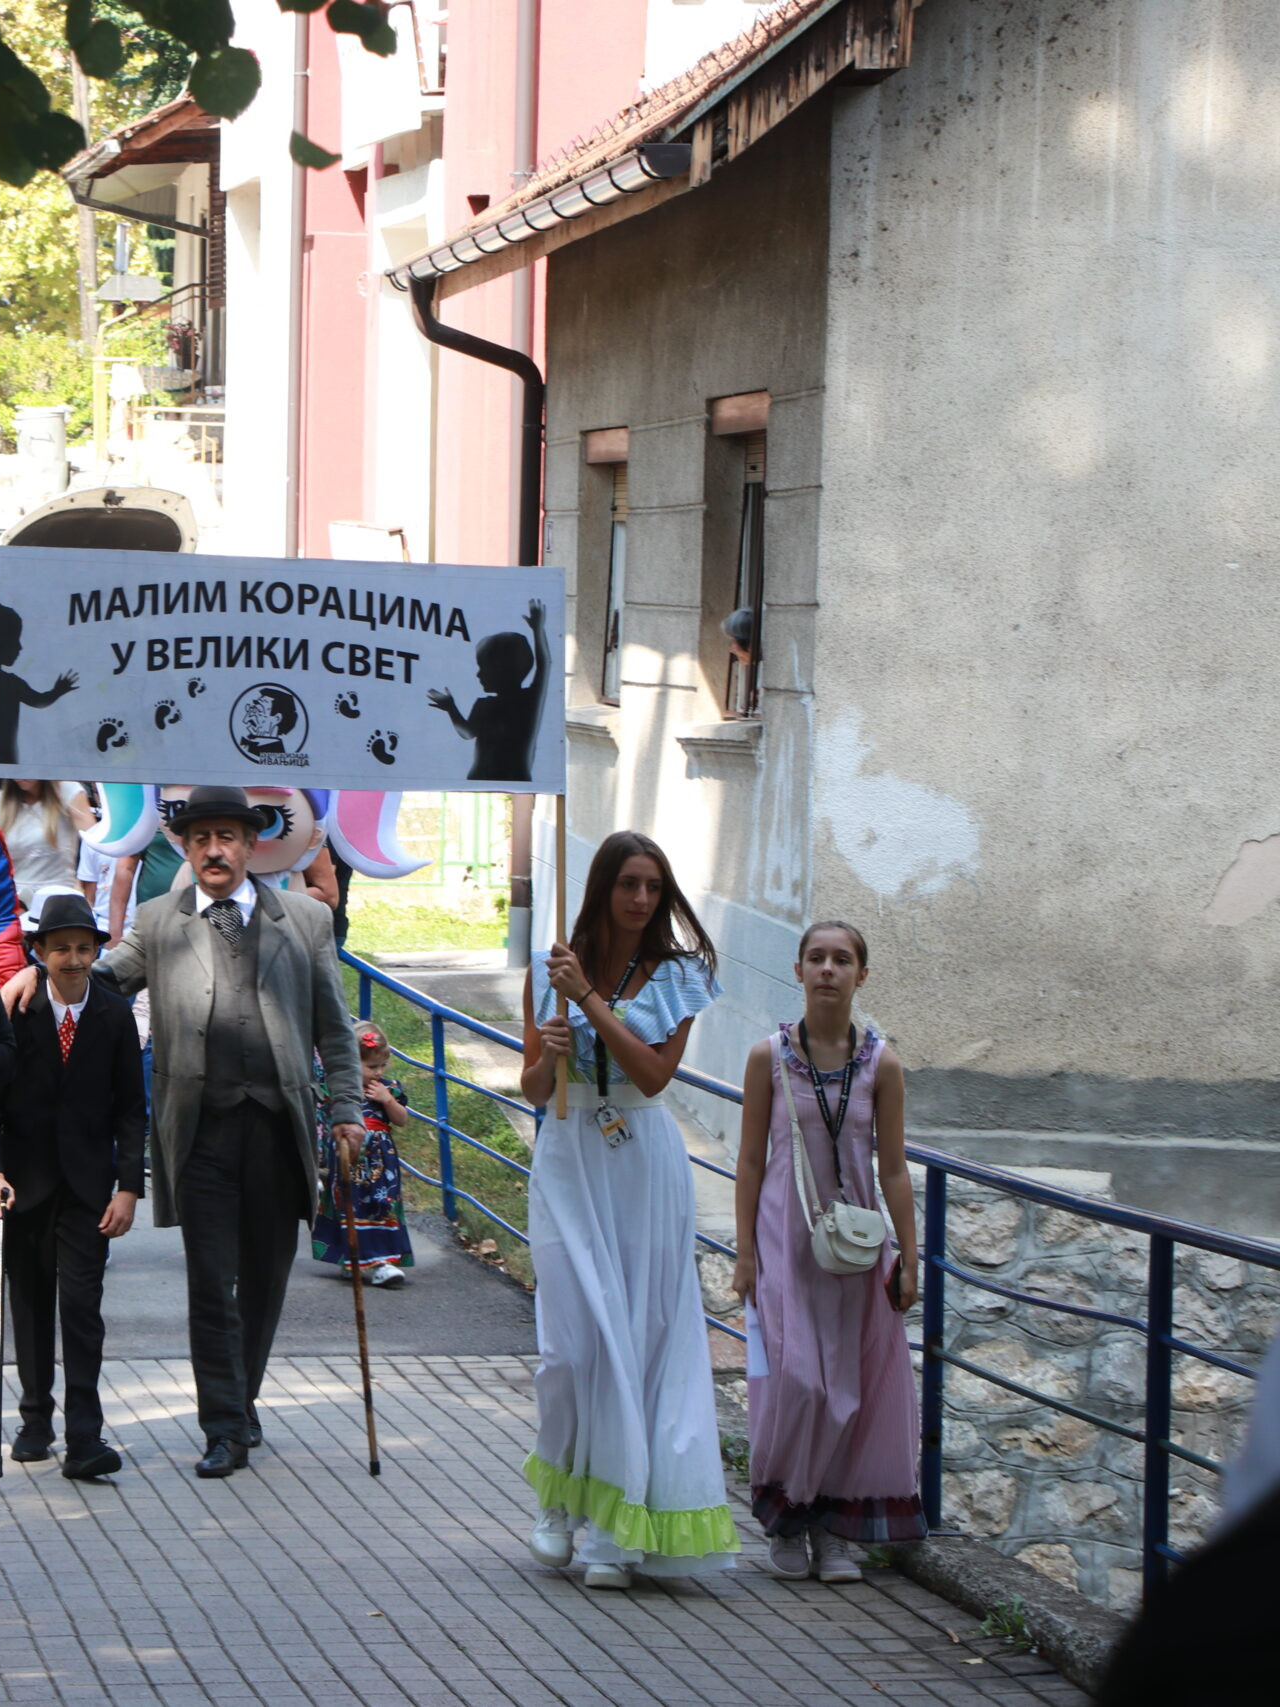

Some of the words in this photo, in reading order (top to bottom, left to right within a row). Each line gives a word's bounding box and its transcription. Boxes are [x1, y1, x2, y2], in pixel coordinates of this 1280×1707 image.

[68, 580, 227, 626] МАЛИМ
[240, 580, 472, 642] КОРАЦИМА
[110, 640, 137, 677] У
[147, 635, 310, 673] ВЕЛИКИ
[320, 640, 420, 685] СВЕТ
